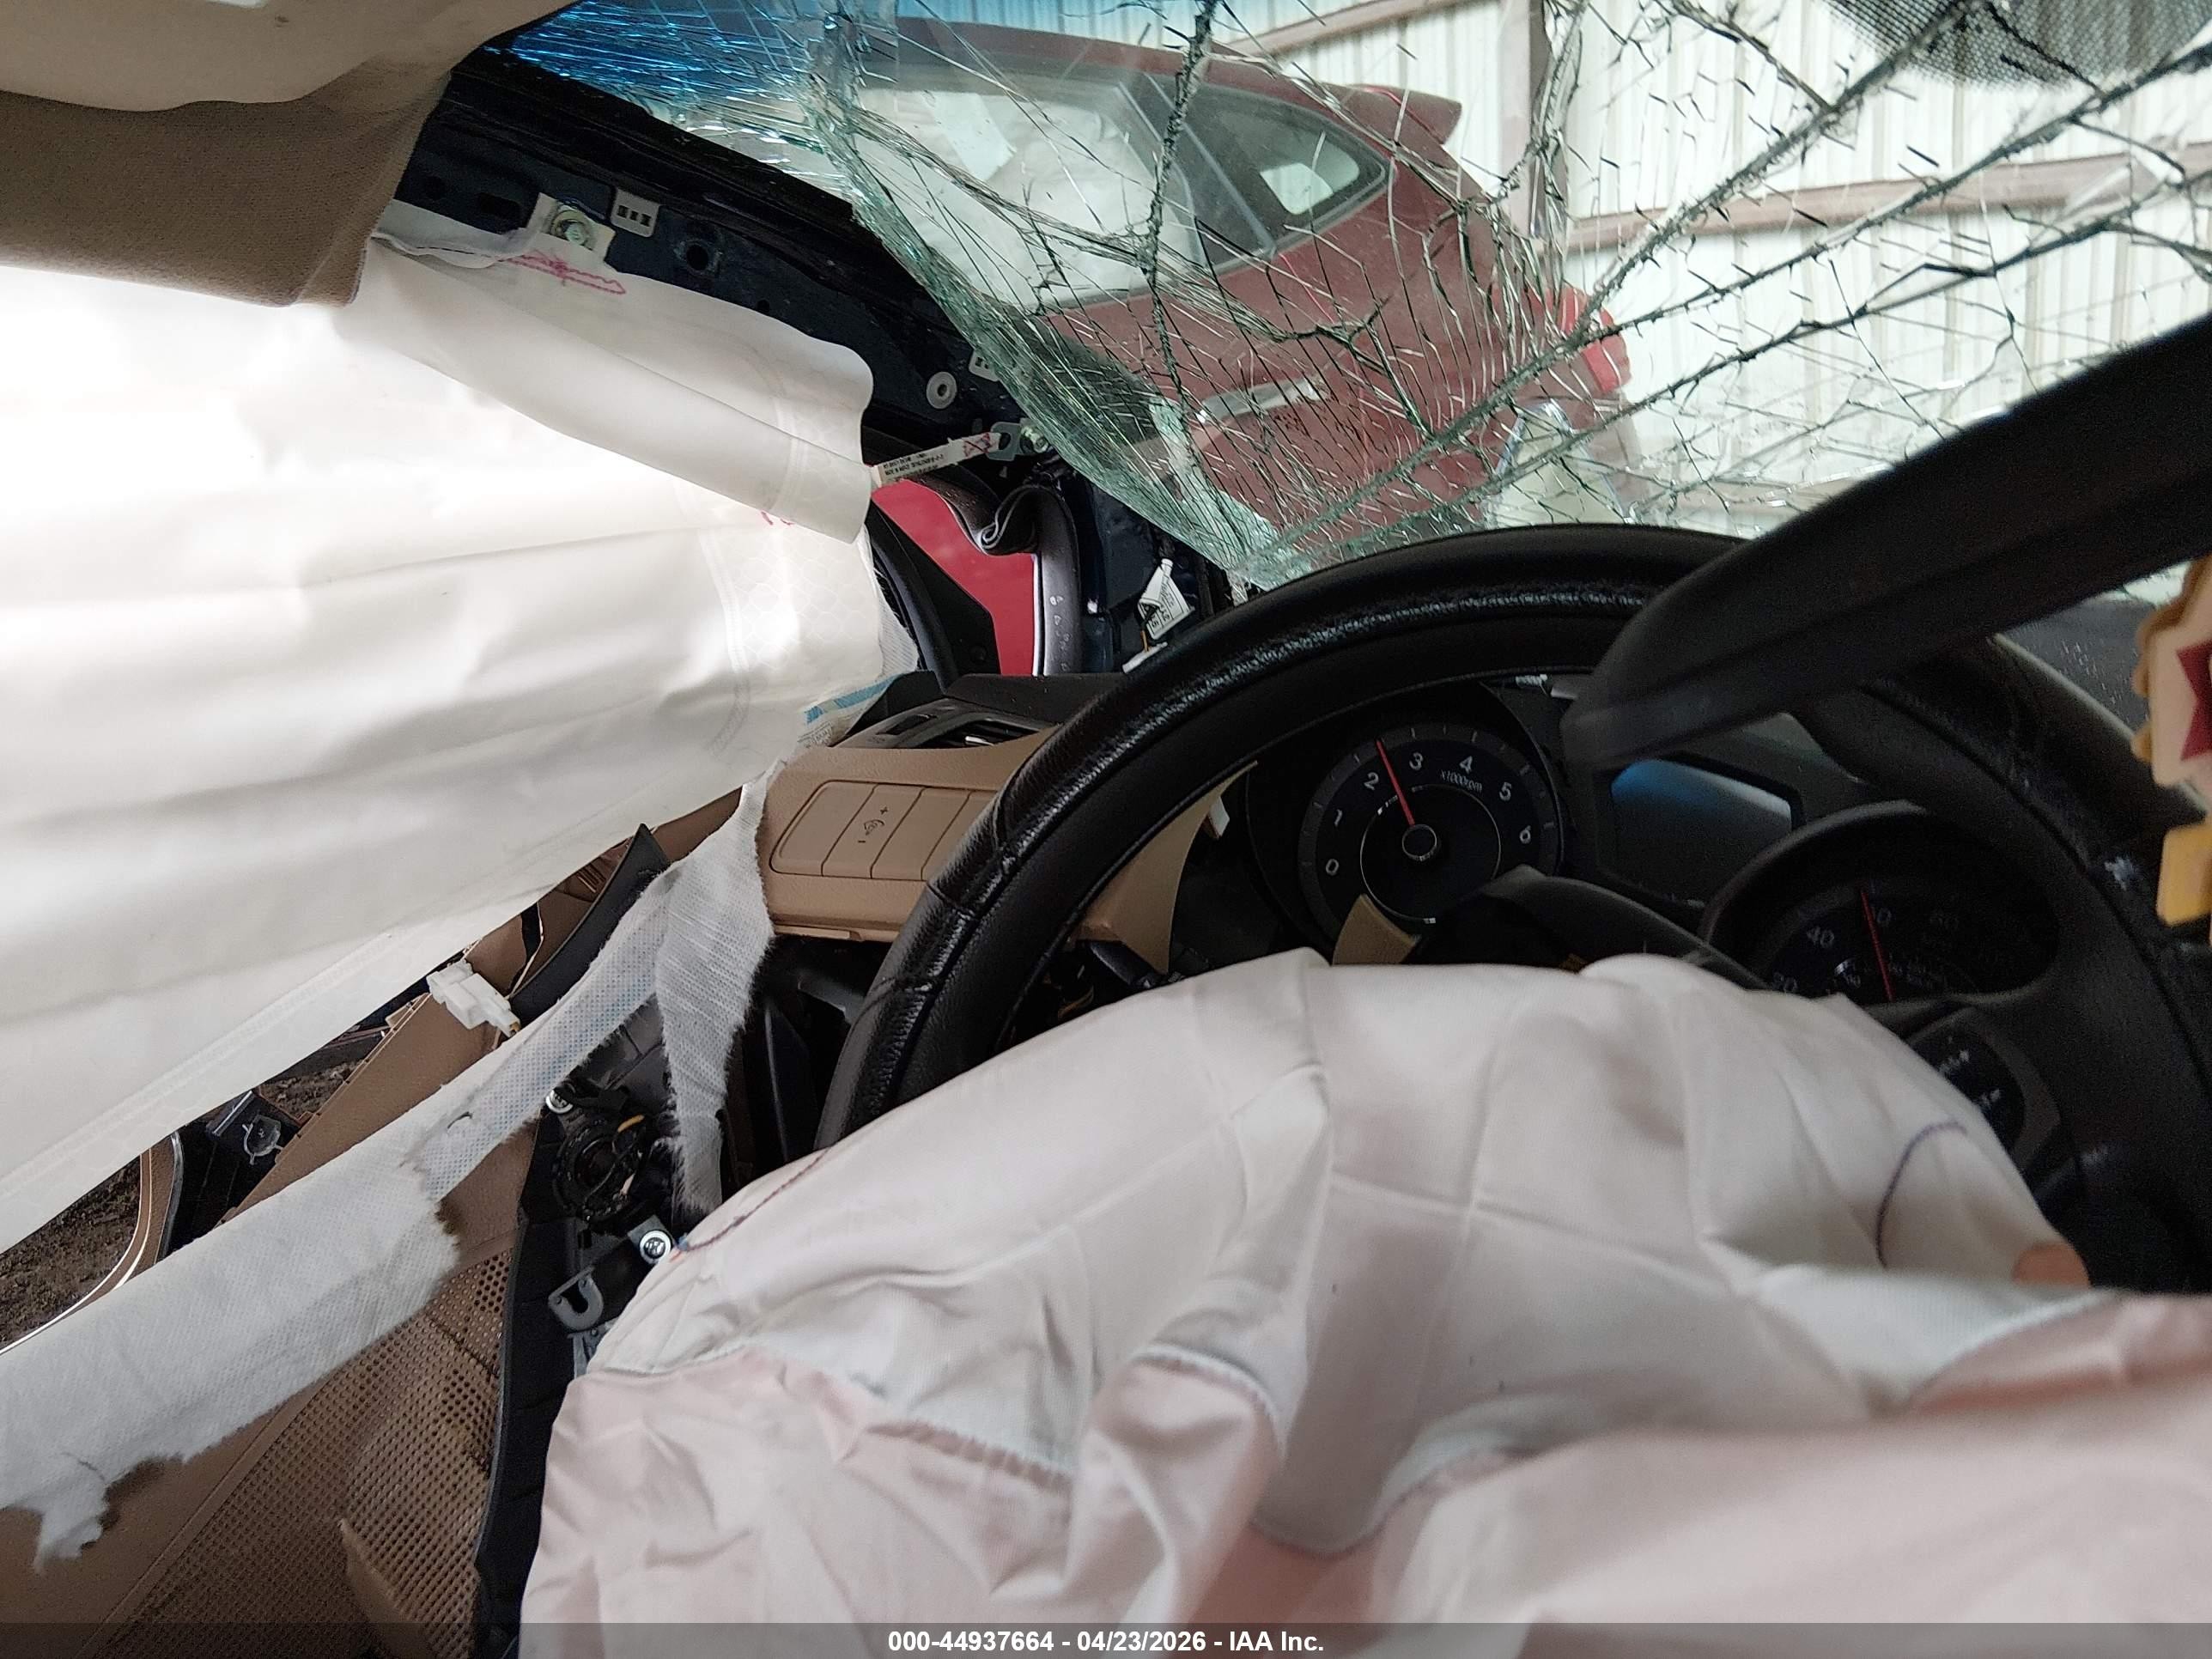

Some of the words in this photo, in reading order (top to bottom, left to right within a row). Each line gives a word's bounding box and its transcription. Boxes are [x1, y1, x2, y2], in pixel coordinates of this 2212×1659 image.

[1408, 752, 1425, 771] 3
[1459, 755, 1474, 774] 4
[1364, 771, 1380, 791] 2
[1498, 781, 1513, 801] 5
[1333, 809, 1344, 827] 1
[1518, 824, 1533, 844] 6
[1325, 858, 1340, 876] 0
[1806, 924, 1836, 950] 40
